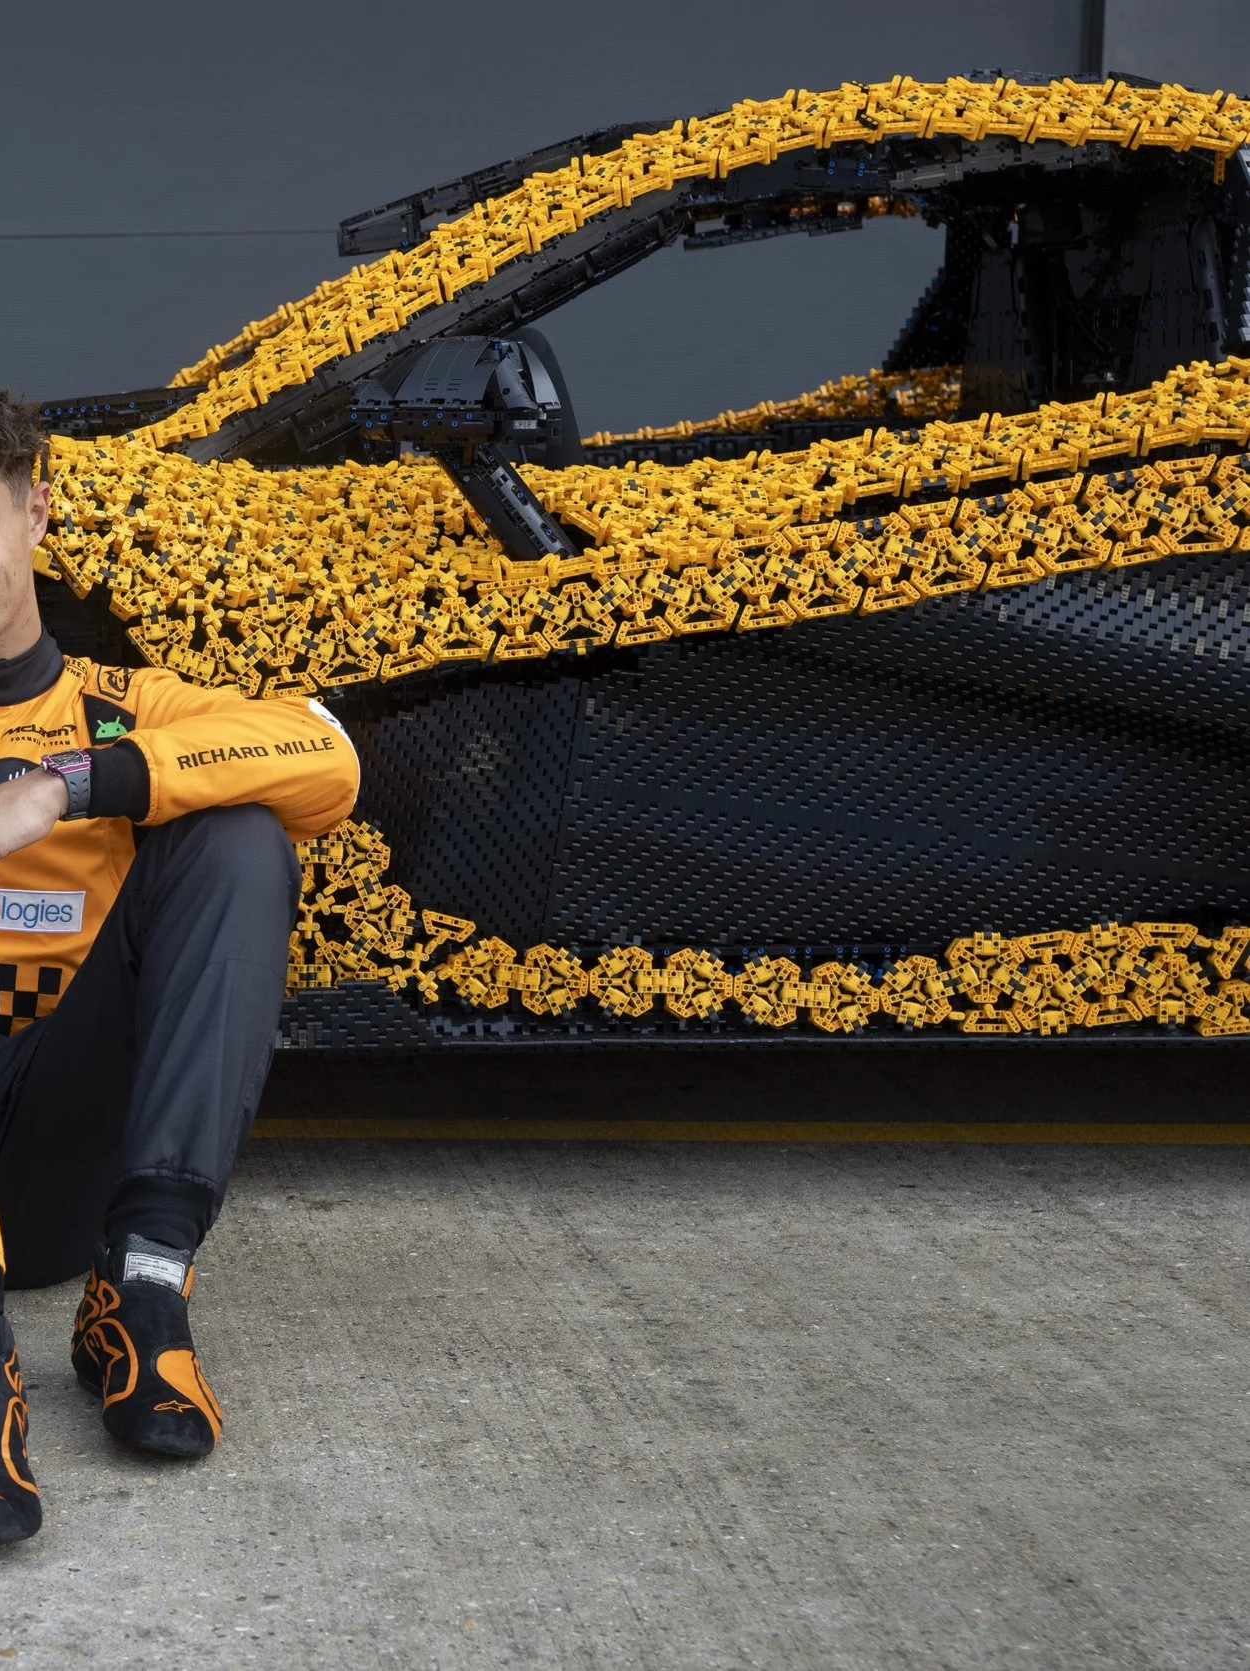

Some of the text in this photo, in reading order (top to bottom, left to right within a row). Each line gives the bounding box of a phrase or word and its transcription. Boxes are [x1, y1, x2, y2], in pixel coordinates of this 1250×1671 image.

[176, 737, 335, 770] RICHARD MILLE
[1, 895, 73, 929] logies
